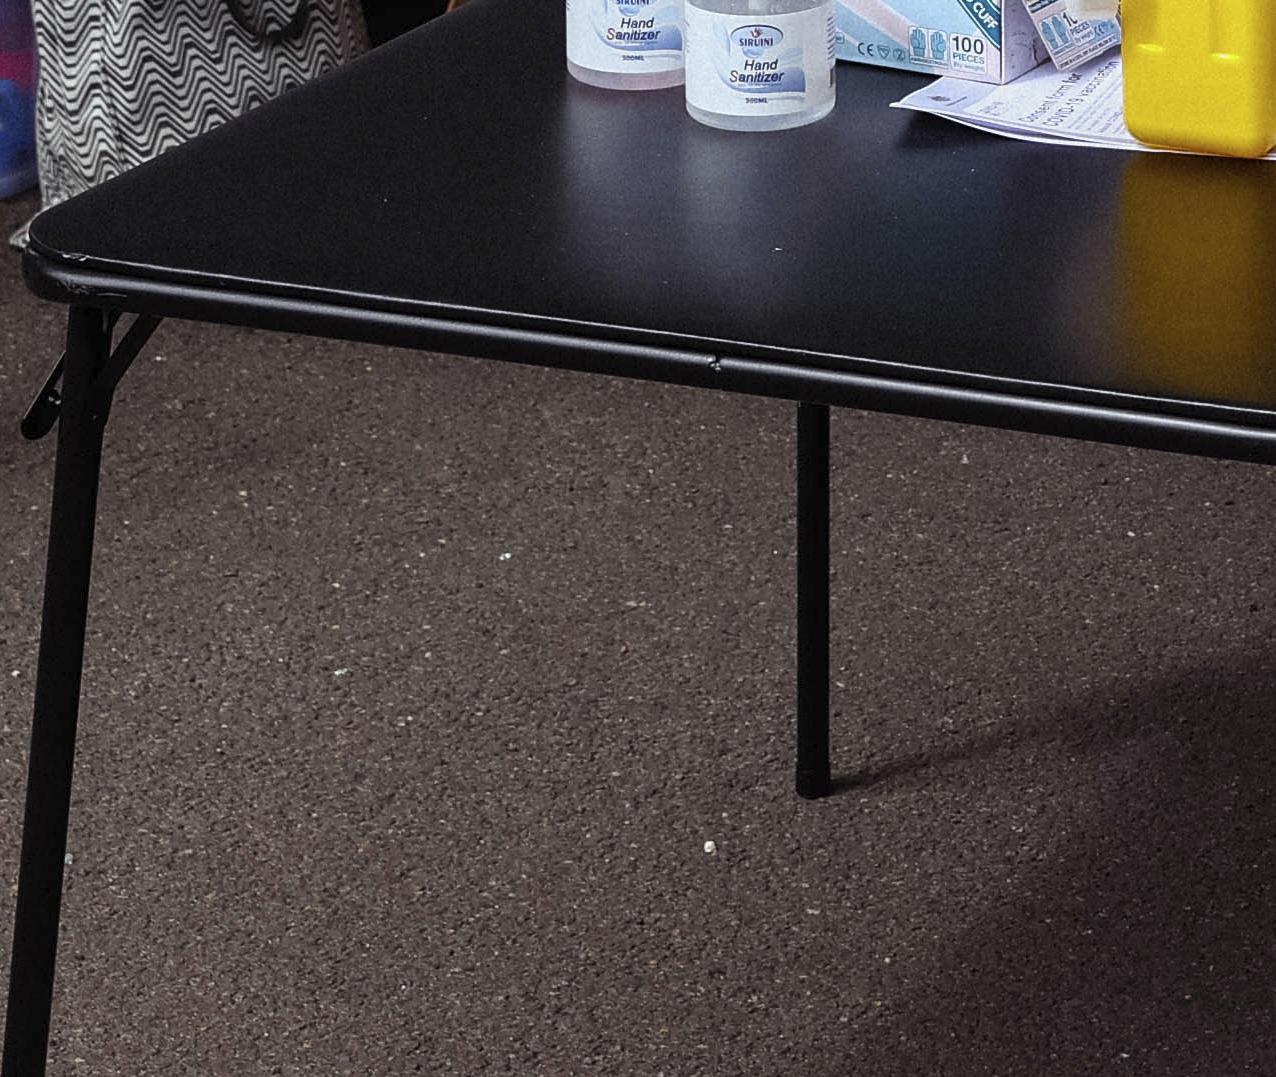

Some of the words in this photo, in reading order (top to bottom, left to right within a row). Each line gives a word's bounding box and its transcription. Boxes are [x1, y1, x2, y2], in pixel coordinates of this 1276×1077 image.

[972, 1, 999, 29] CUFF
[620, 17, 655, 29] Hand
[606, 27, 661, 41] Sanitizer
[738, 37, 774, 47] SIRUINI
[952, 35, 985, 55] 100
[743, 58, 779, 71] Hand
[952, 53, 986, 65] PIECES
[729, 69, 785, 83] Sanitizer
[1042, 97, 1085, 127] COVID-19
